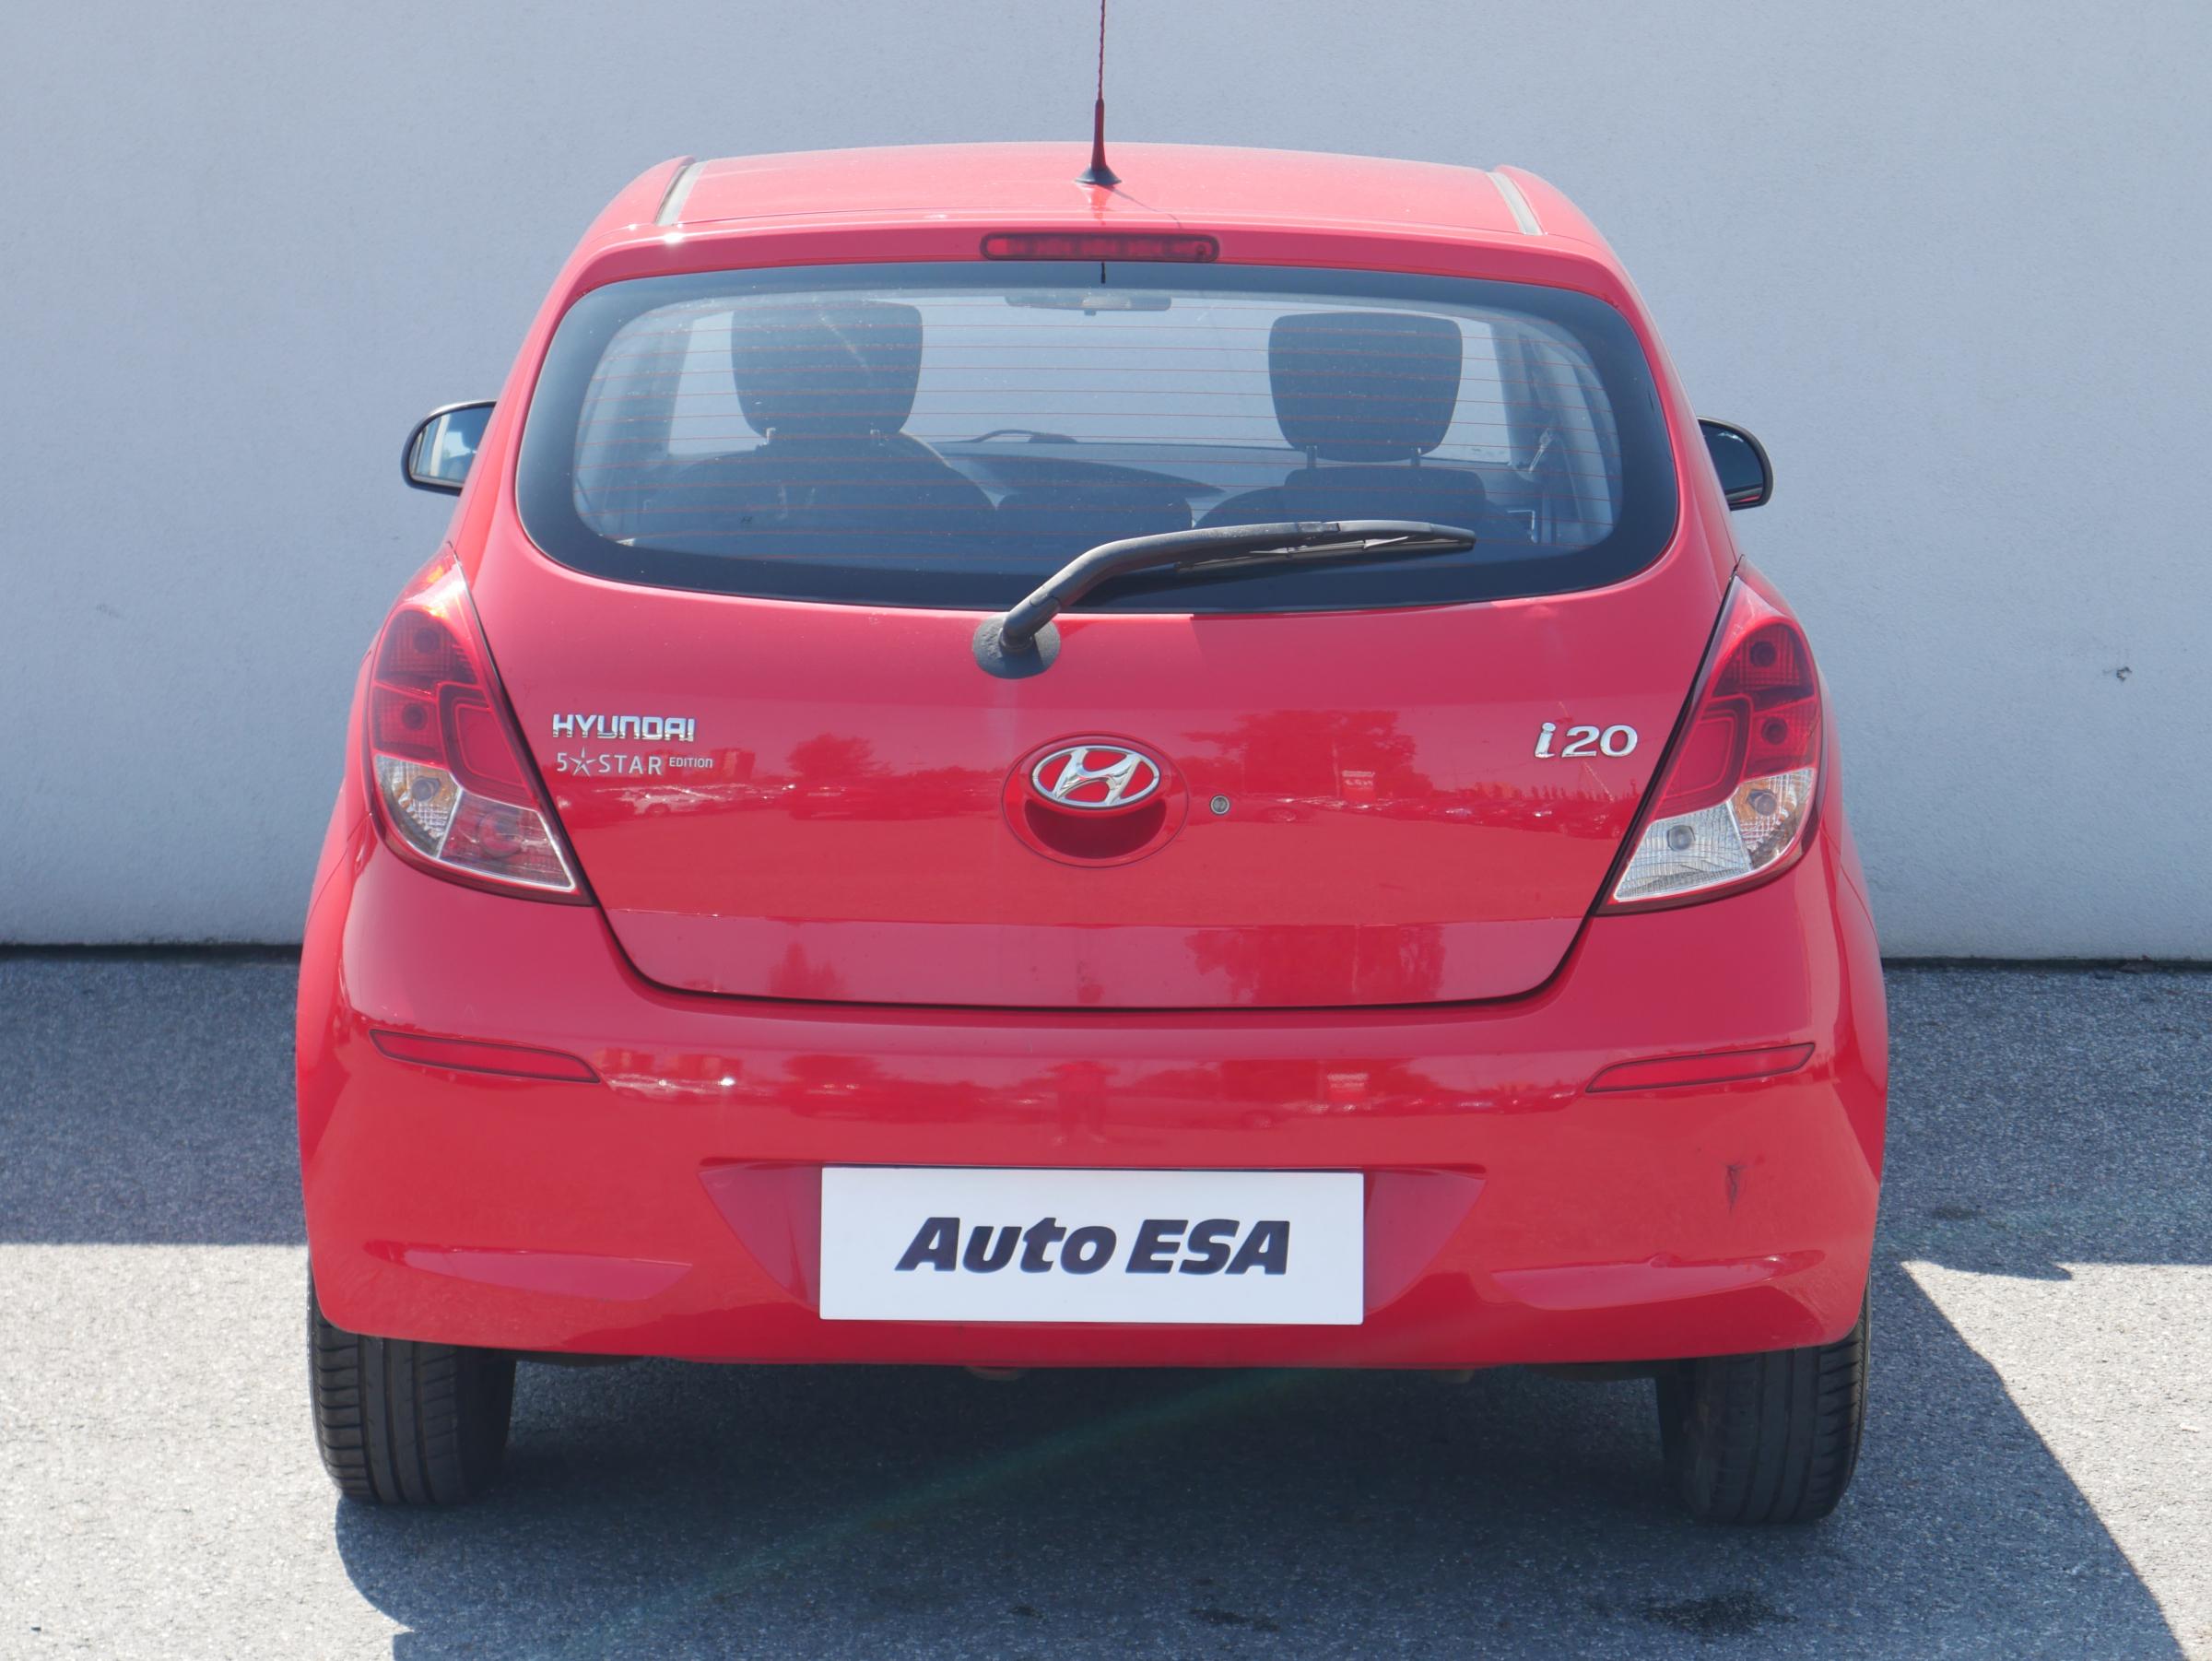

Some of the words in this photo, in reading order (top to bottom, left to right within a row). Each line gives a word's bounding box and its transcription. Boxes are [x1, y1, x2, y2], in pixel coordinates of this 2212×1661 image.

[552, 713, 695, 742] HYUNDAI
[556, 752, 568, 772] 5
[598, 754, 663, 775] STAR
[668, 756, 713, 769] EDITION
[894, 1217, 1117, 1275] Auto
[1124, 1219, 1290, 1276] ESA
